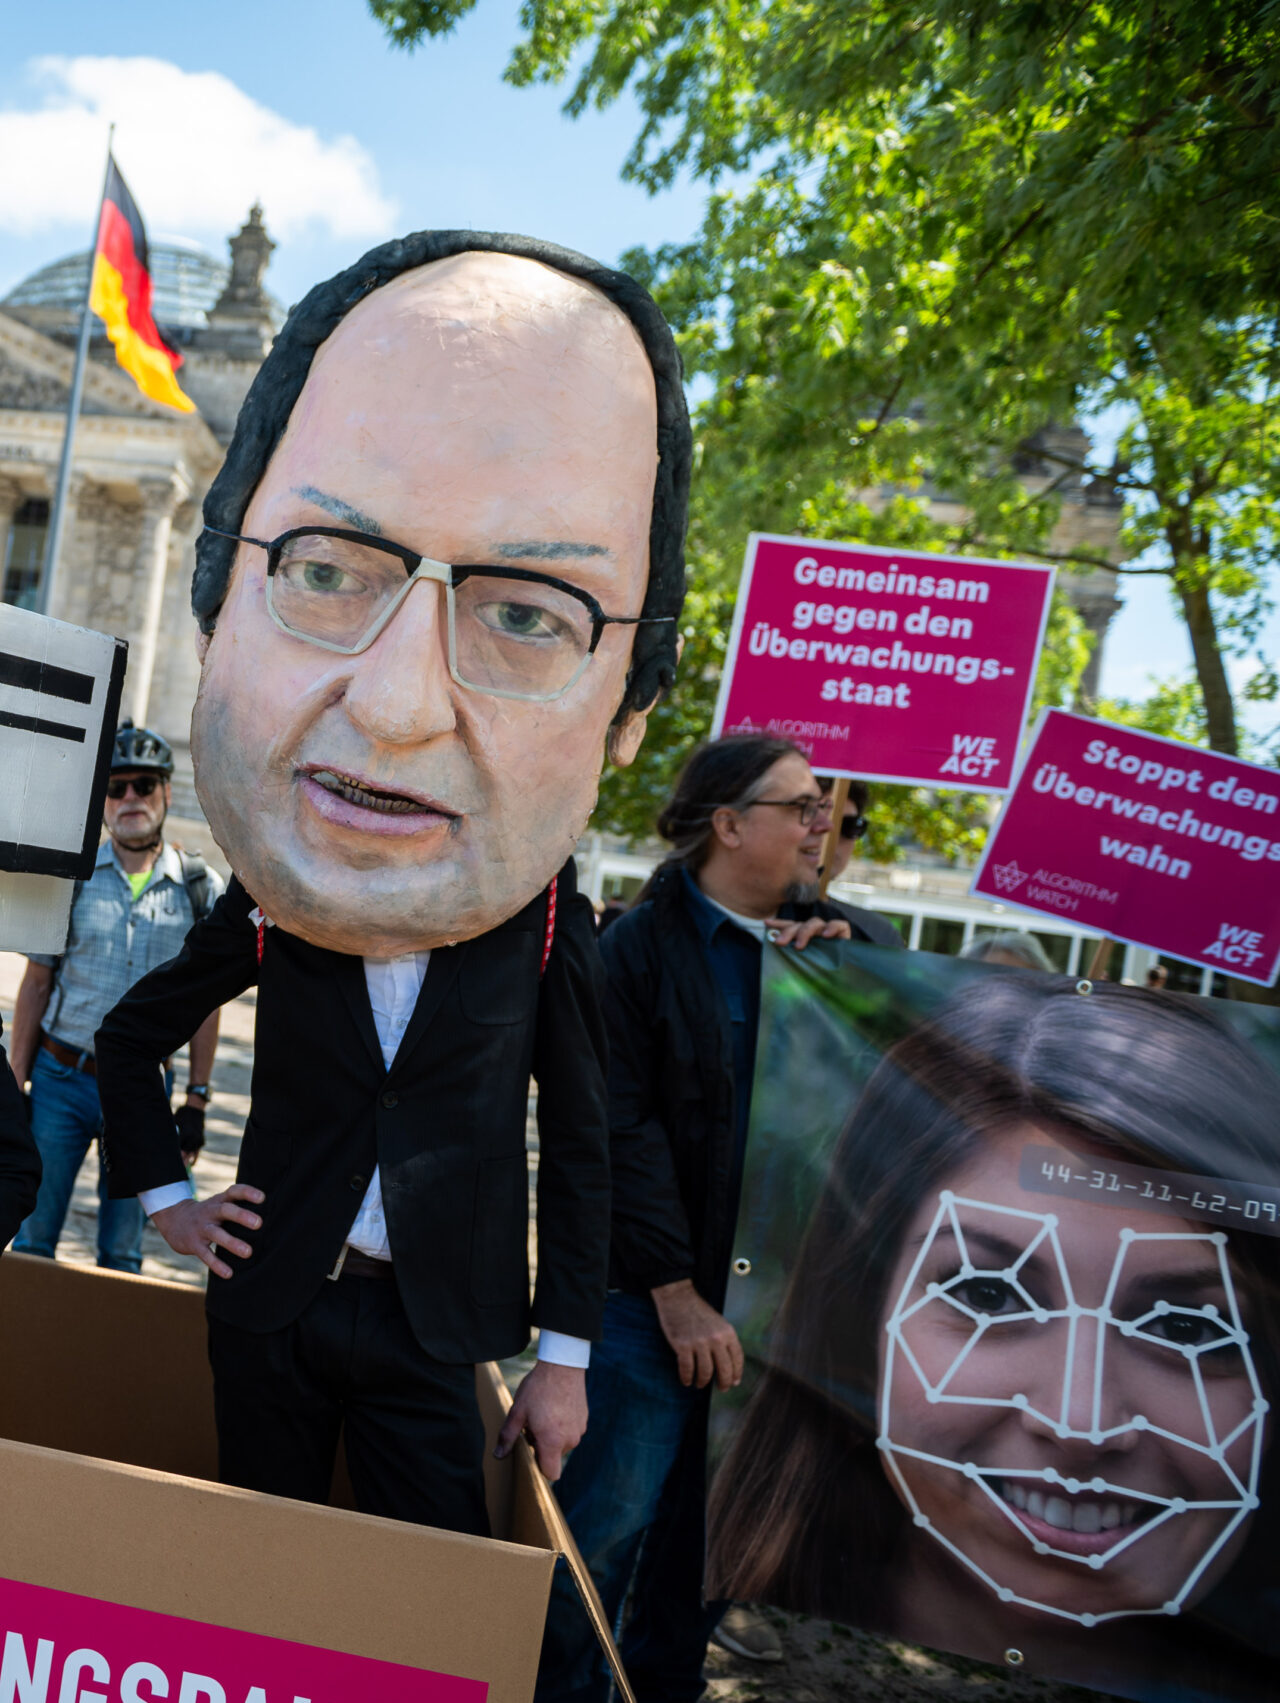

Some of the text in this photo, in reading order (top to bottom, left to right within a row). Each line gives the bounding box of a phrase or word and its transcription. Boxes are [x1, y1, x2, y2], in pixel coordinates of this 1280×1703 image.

[794, 557, 989, 603] Gemeinsam
[793, 601, 973, 639] gegen den
[748, 622, 1015, 684] Überwachungs-
[821, 677, 910, 708] staat
[766, 718, 850, 741] ALGORITHM
[952, 735, 996, 757] WE
[1082, 739, 1278, 813] Stoppt den
[1100, 836, 1192, 879] wahn
[1027, 884, 1078, 911] WATCH
[1032, 868, 1119, 905] ALGORITHM
[1218, 923, 1264, 949] WE
[1041, 1162, 1280, 1221] 44-31-11-62-09
